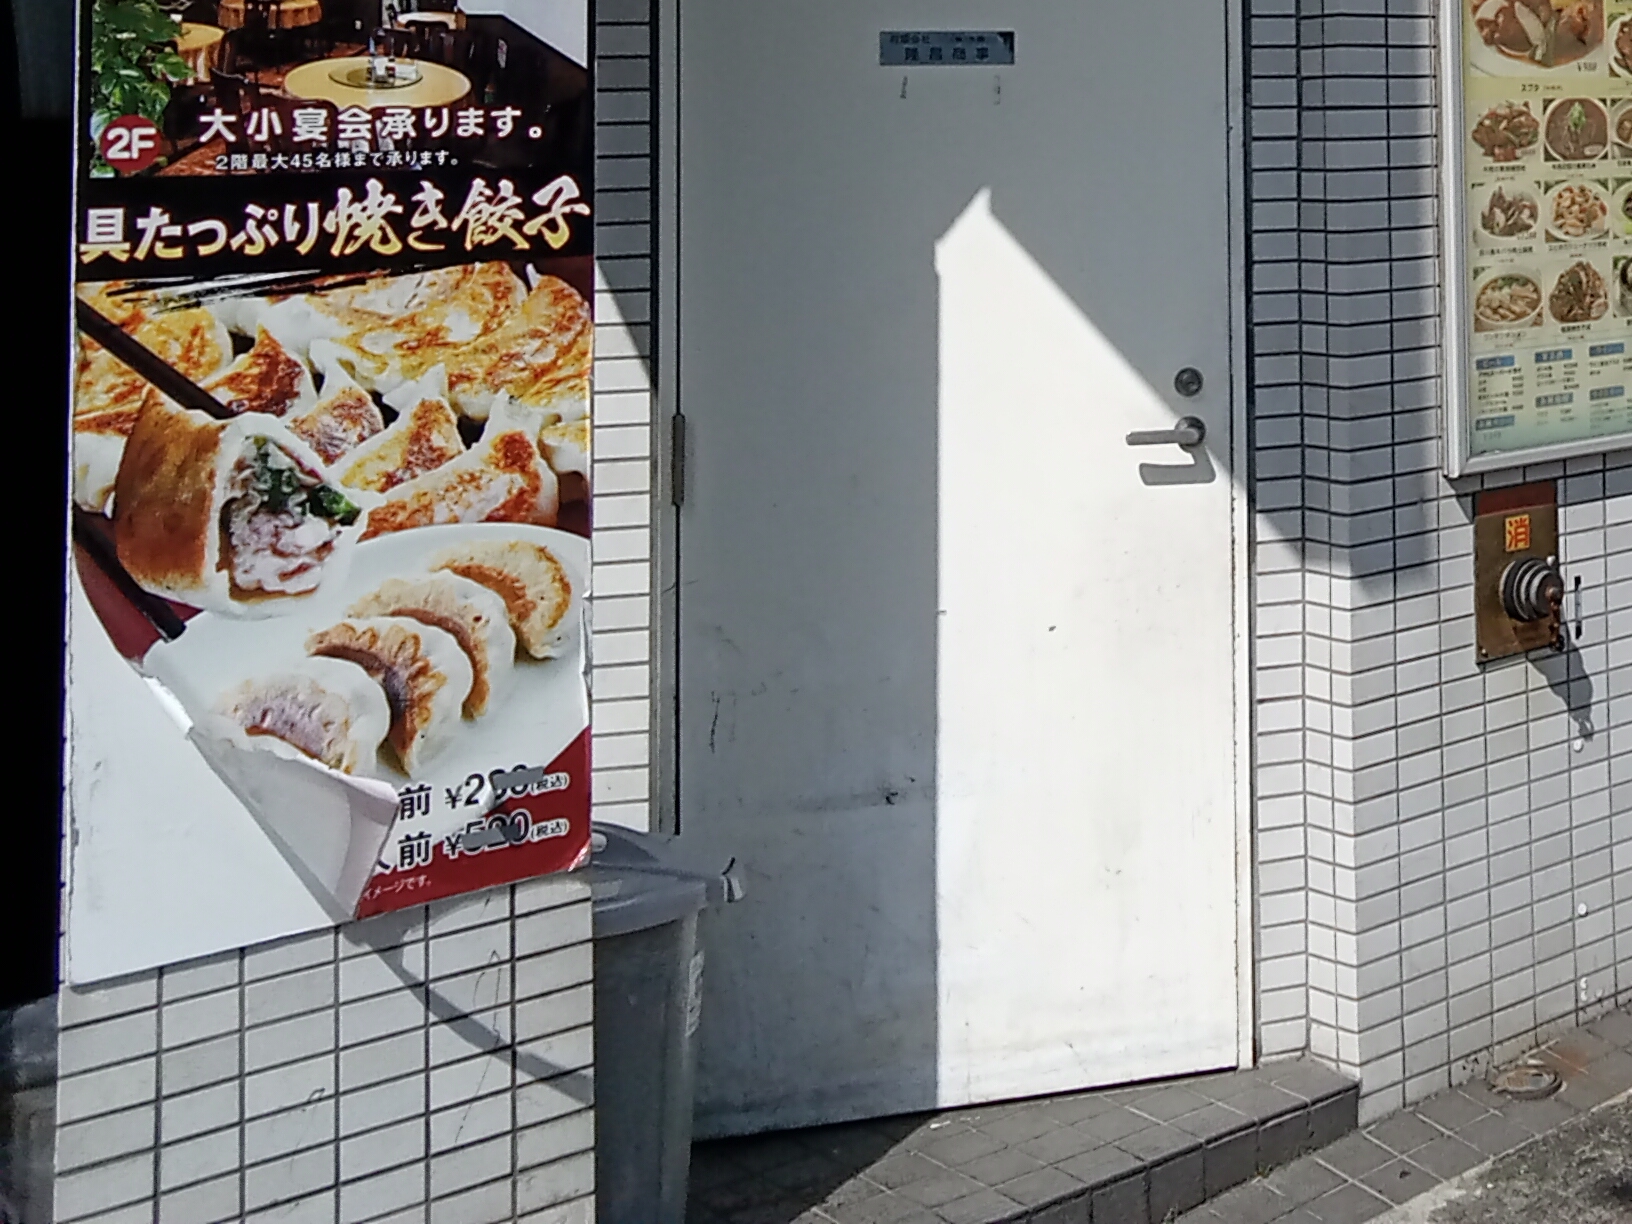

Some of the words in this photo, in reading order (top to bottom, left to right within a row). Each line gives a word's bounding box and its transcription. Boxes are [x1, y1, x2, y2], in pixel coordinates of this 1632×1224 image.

[200, 106, 542, 143] 大小宴会承ります。
[106, 126, 158, 160] 2F
[214, 149, 460, 171] 2階最大45名様まで承ります。
[1508, 517, 1530, 549] 消
